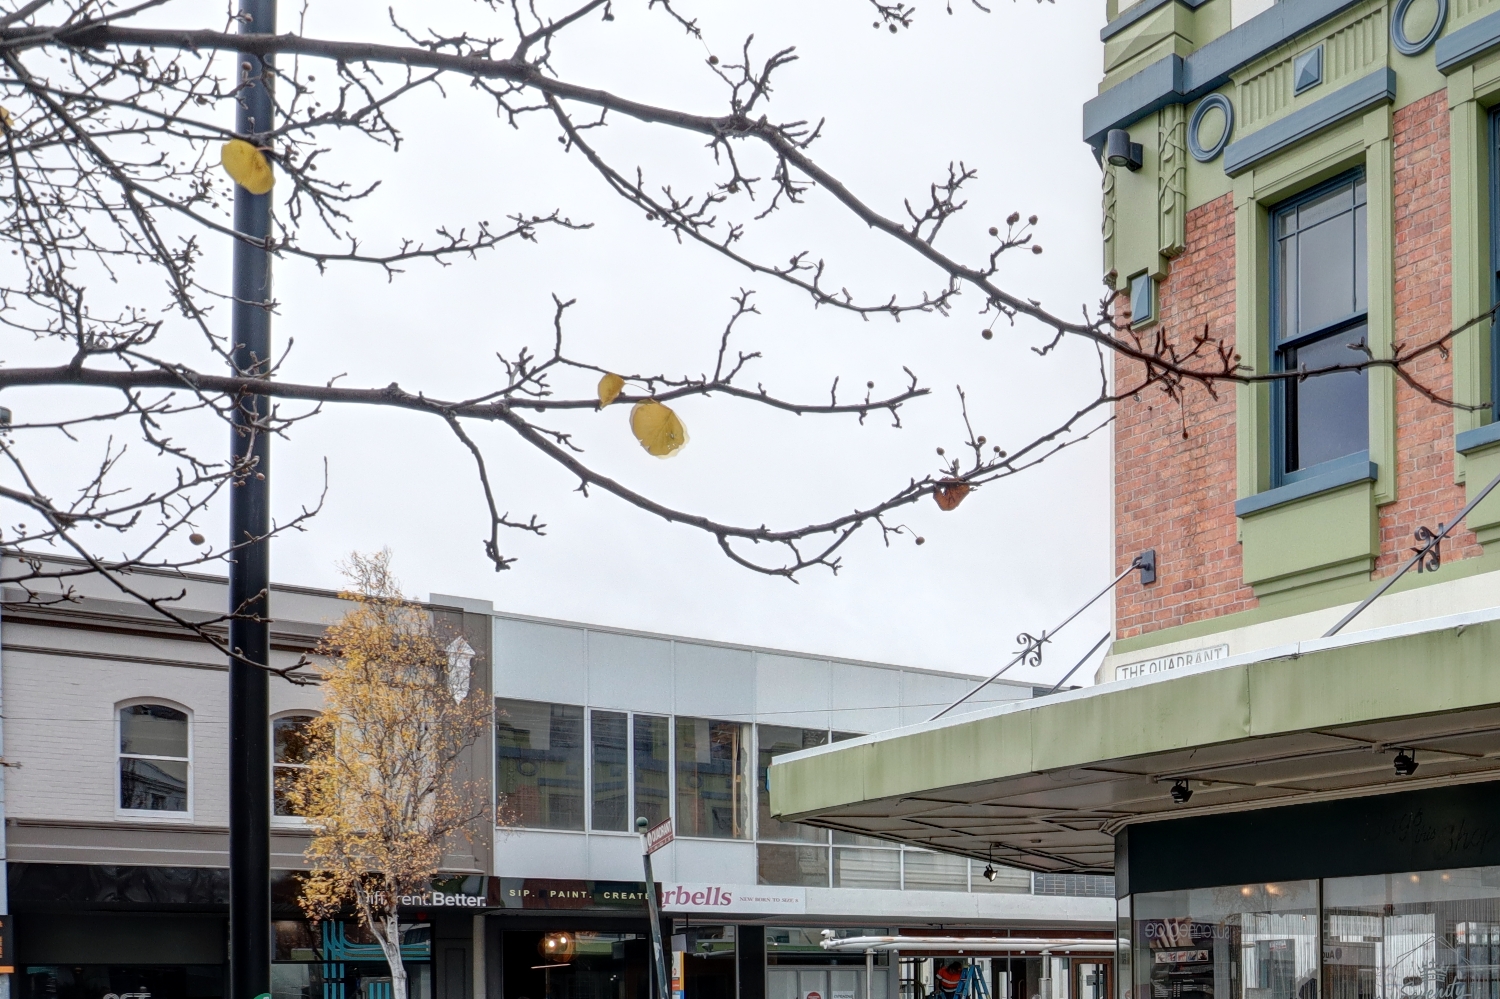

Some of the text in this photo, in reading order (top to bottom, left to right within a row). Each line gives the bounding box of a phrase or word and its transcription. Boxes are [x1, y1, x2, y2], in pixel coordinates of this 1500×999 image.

[1122, 648, 1222, 679] THE QUADRANT
[357, 890, 487, 907] Diffrent.Better.
[509, 889, 536, 897] SIP.
[550, 890, 593, 899] PAINT.
[662, 885, 732, 908] rbells
